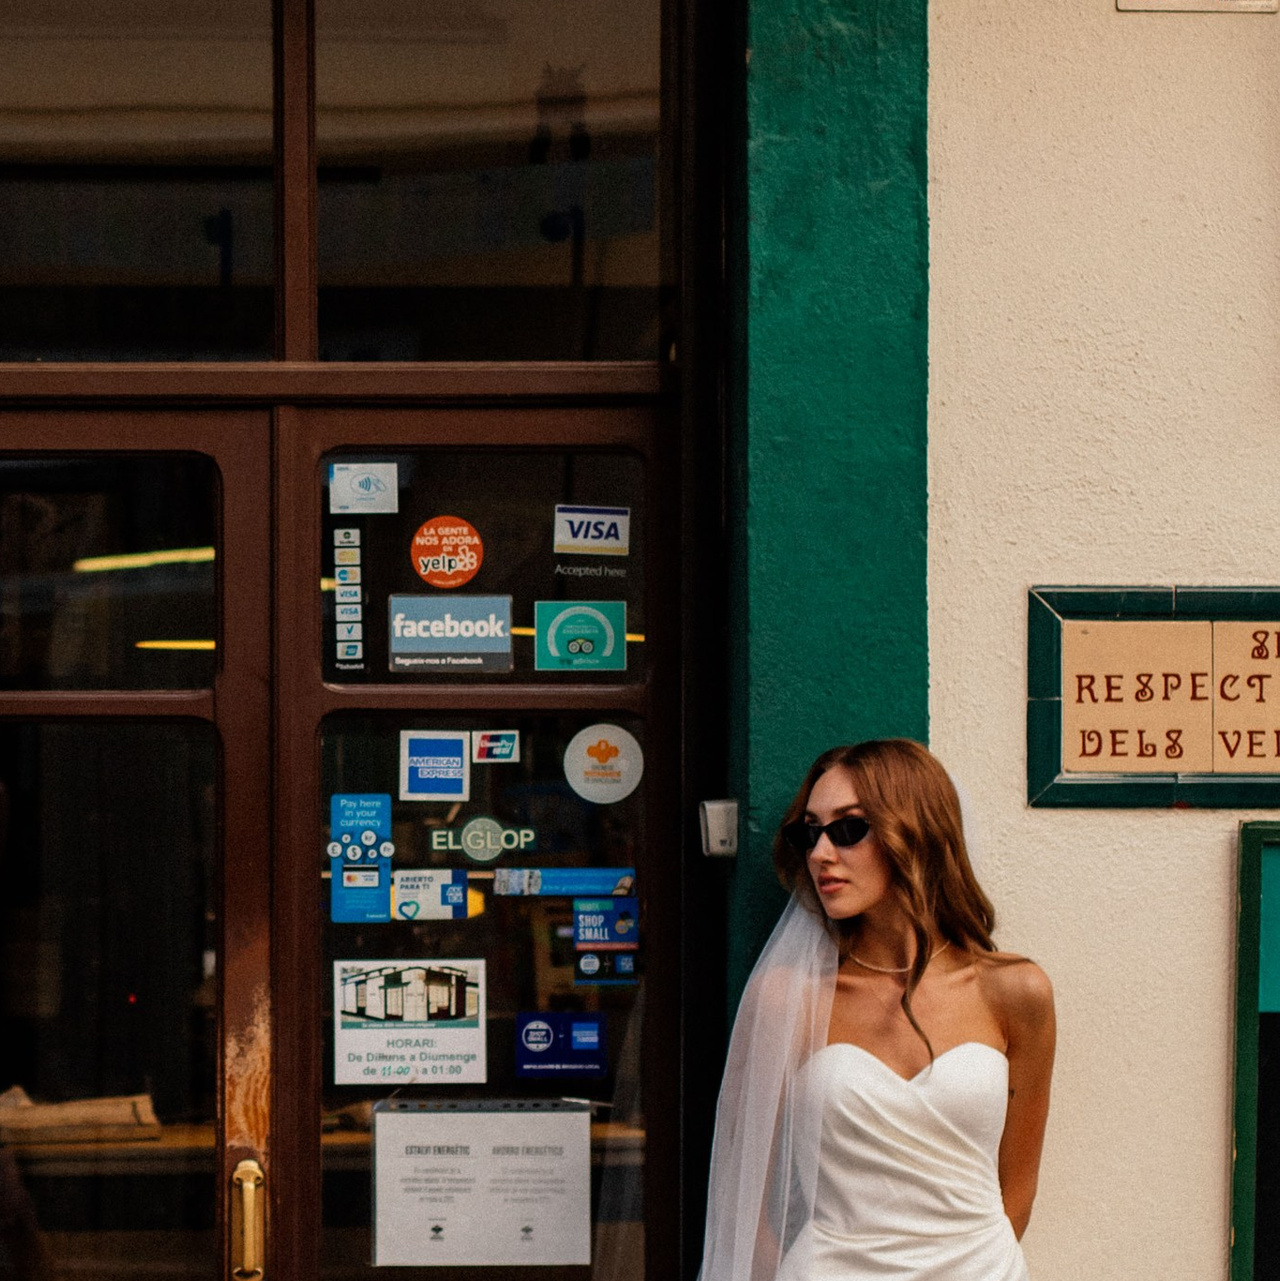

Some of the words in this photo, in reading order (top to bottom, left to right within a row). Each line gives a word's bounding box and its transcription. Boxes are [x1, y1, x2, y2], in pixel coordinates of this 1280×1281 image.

[437, 526, 469, 536] GENTE
[565, 519, 620, 541] VISA
[415, 535, 439, 546] NOS
[441, 535, 480, 545] ADORA
[420, 554, 458, 573] yelp
[555, 564, 602, 577] Accepted
[604, 566, 627, 577] here
[1078, 728, 1184, 760] DELS
[408, 757, 461, 767] AMERICAN
[419, 768, 464, 778] EXPRESS
[339, 798, 356, 810] Pay
[359, 798, 382, 808] here
[356, 810, 377, 819] your
[339, 819, 382, 828] currency
[432, 830, 463, 850] EL
[465, 829, 536, 850] GLOP
[399, 875, 434, 884] ABIERTO
[399, 883, 421, 891] PARA
[578, 914, 605, 927] SHOP
[578, 927, 610, 941] SMALL
[386, 1039, 437, 1049] HORARI:
[348, 1053, 363, 1062] De
[419, 1051, 477, 1064] Diumenge
[363, 1066, 377, 1075] de
[421, 1067, 429, 1075] a
[431, 1065, 463, 1075] 01:00
